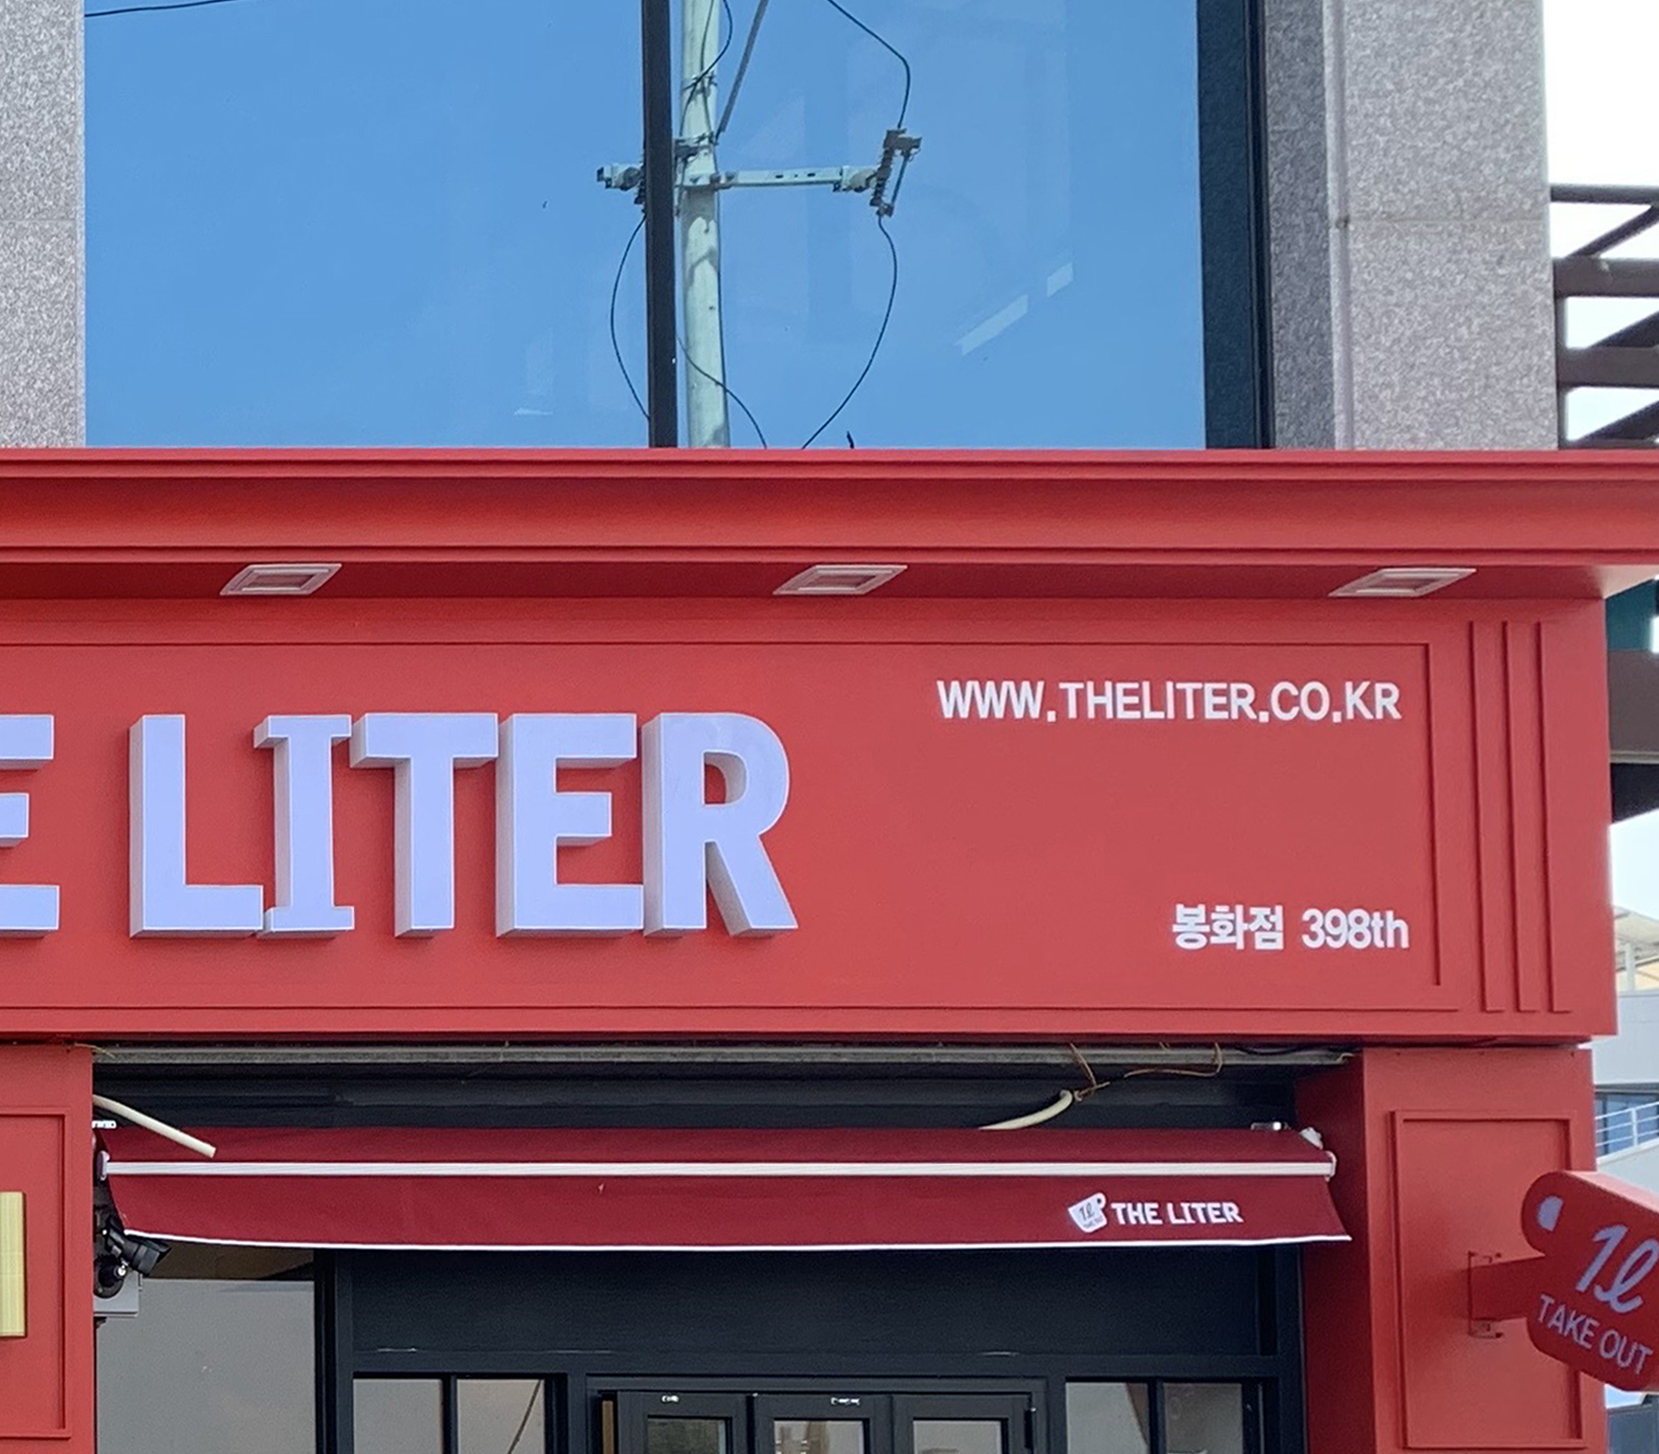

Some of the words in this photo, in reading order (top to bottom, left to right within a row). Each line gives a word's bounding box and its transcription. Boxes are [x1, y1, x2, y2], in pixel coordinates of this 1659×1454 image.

[936, 680, 1403, 723] WWW.THELITER.CO.KR
[129, 713, 799, 938] LITER
[1172, 903, 1284, 950] 봉화점
[1301, 907, 1410, 949] 398th
[1111, 1202, 1163, 1225] THE
[1167, 1202, 1244, 1225] LITER
[1537, 1294, 1600, 1349] TAKE
[1599, 1330, 1654, 1374] OUT
